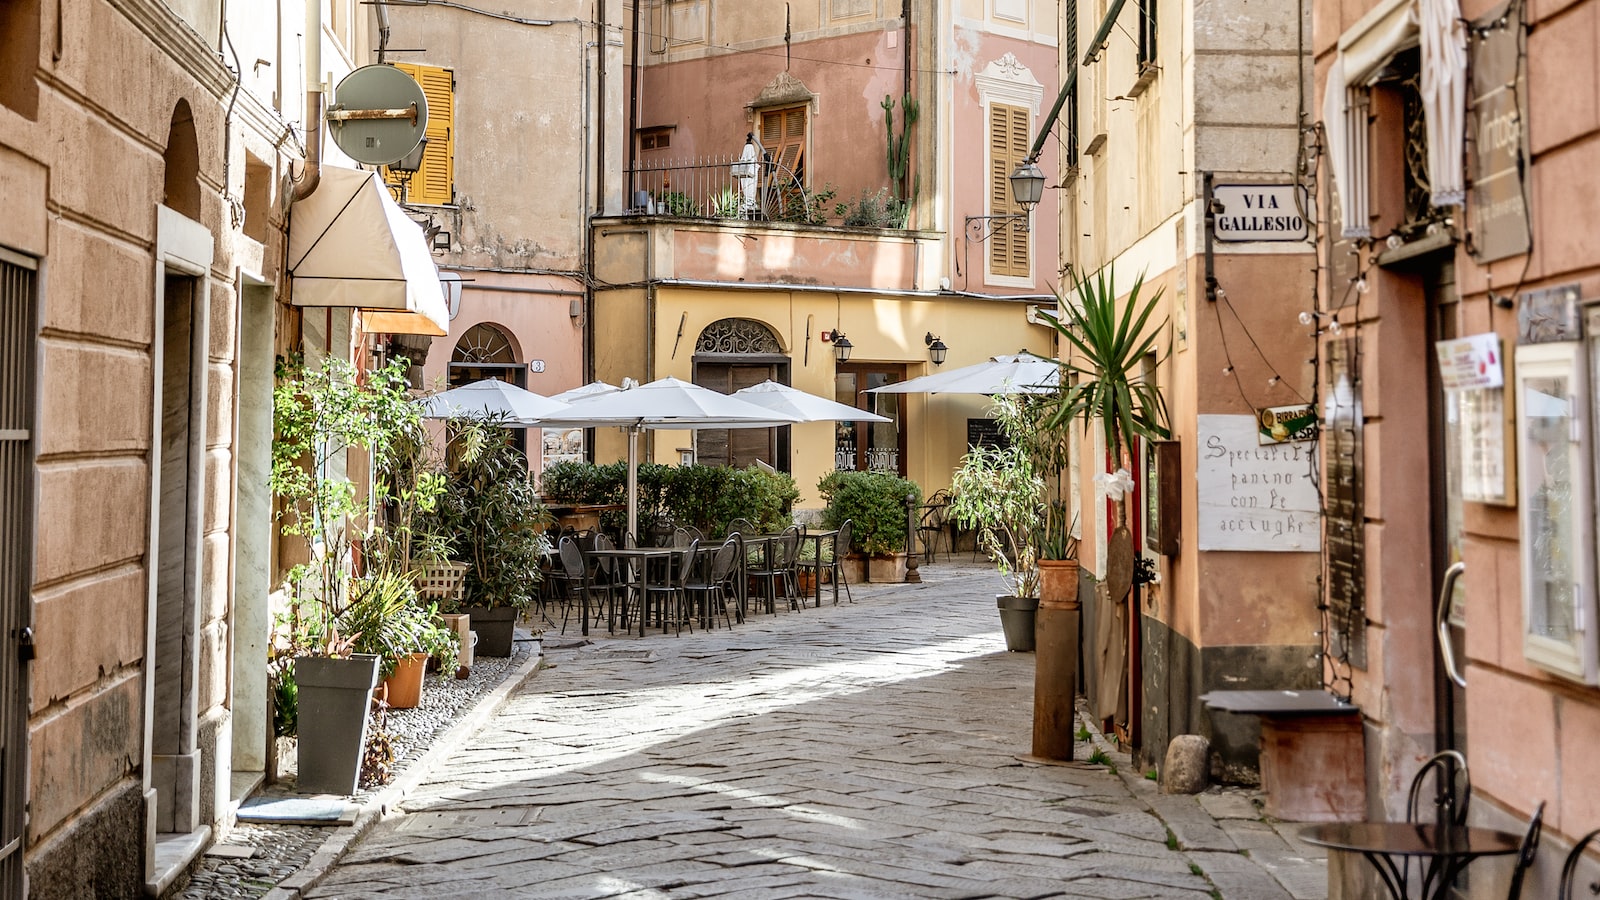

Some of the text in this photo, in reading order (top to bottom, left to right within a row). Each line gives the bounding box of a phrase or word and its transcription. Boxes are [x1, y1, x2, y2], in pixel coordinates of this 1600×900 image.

[1242, 194, 1279, 209] VIA
[1219, 216, 1302, 231] GALLESIO
[535, 361, 541, 371] 3
[1276, 410, 1299, 424] BIRRA
[1231, 473, 1293, 490] panino
[1231, 488, 1286, 508] con le
[1220, 514, 1304, 540] acciughe
